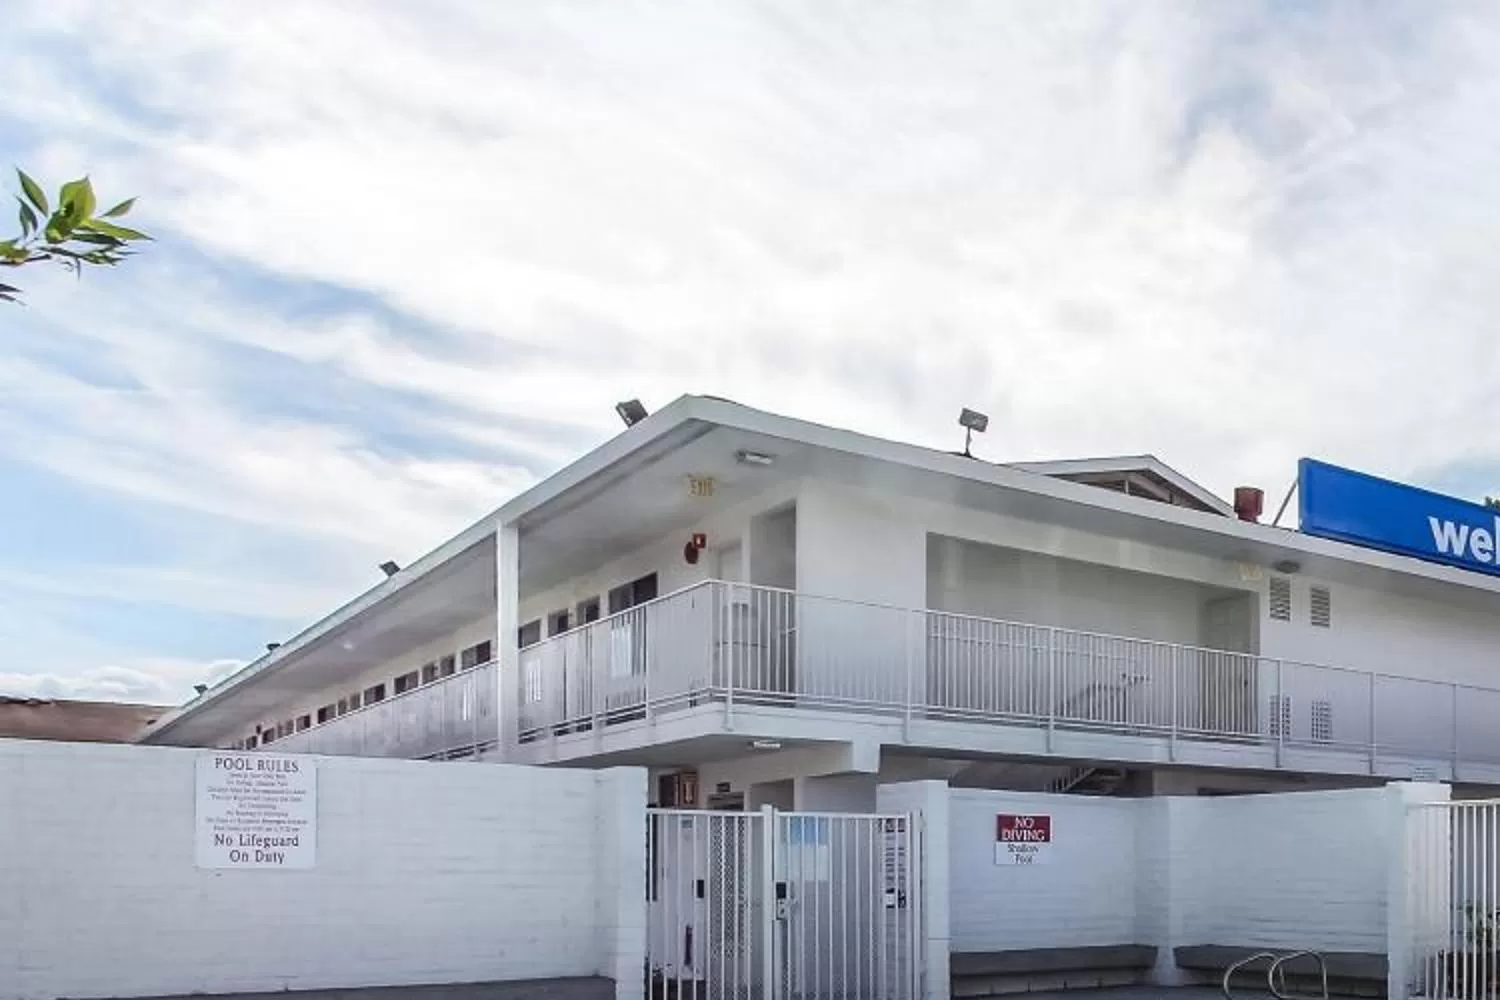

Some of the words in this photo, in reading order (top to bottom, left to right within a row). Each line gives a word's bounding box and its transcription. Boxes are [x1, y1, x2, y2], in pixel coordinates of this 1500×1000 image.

[214, 757, 253, 771] POOL
[257, 759, 299, 773] RULES
[1014, 816, 1035, 829] NO
[214, 833, 233, 846] No
[239, 833, 299, 849] Lifeguard
[1001, 828, 1045, 841] DIVING
[229, 849, 249, 862] On
[255, 849, 285, 864] Duty
